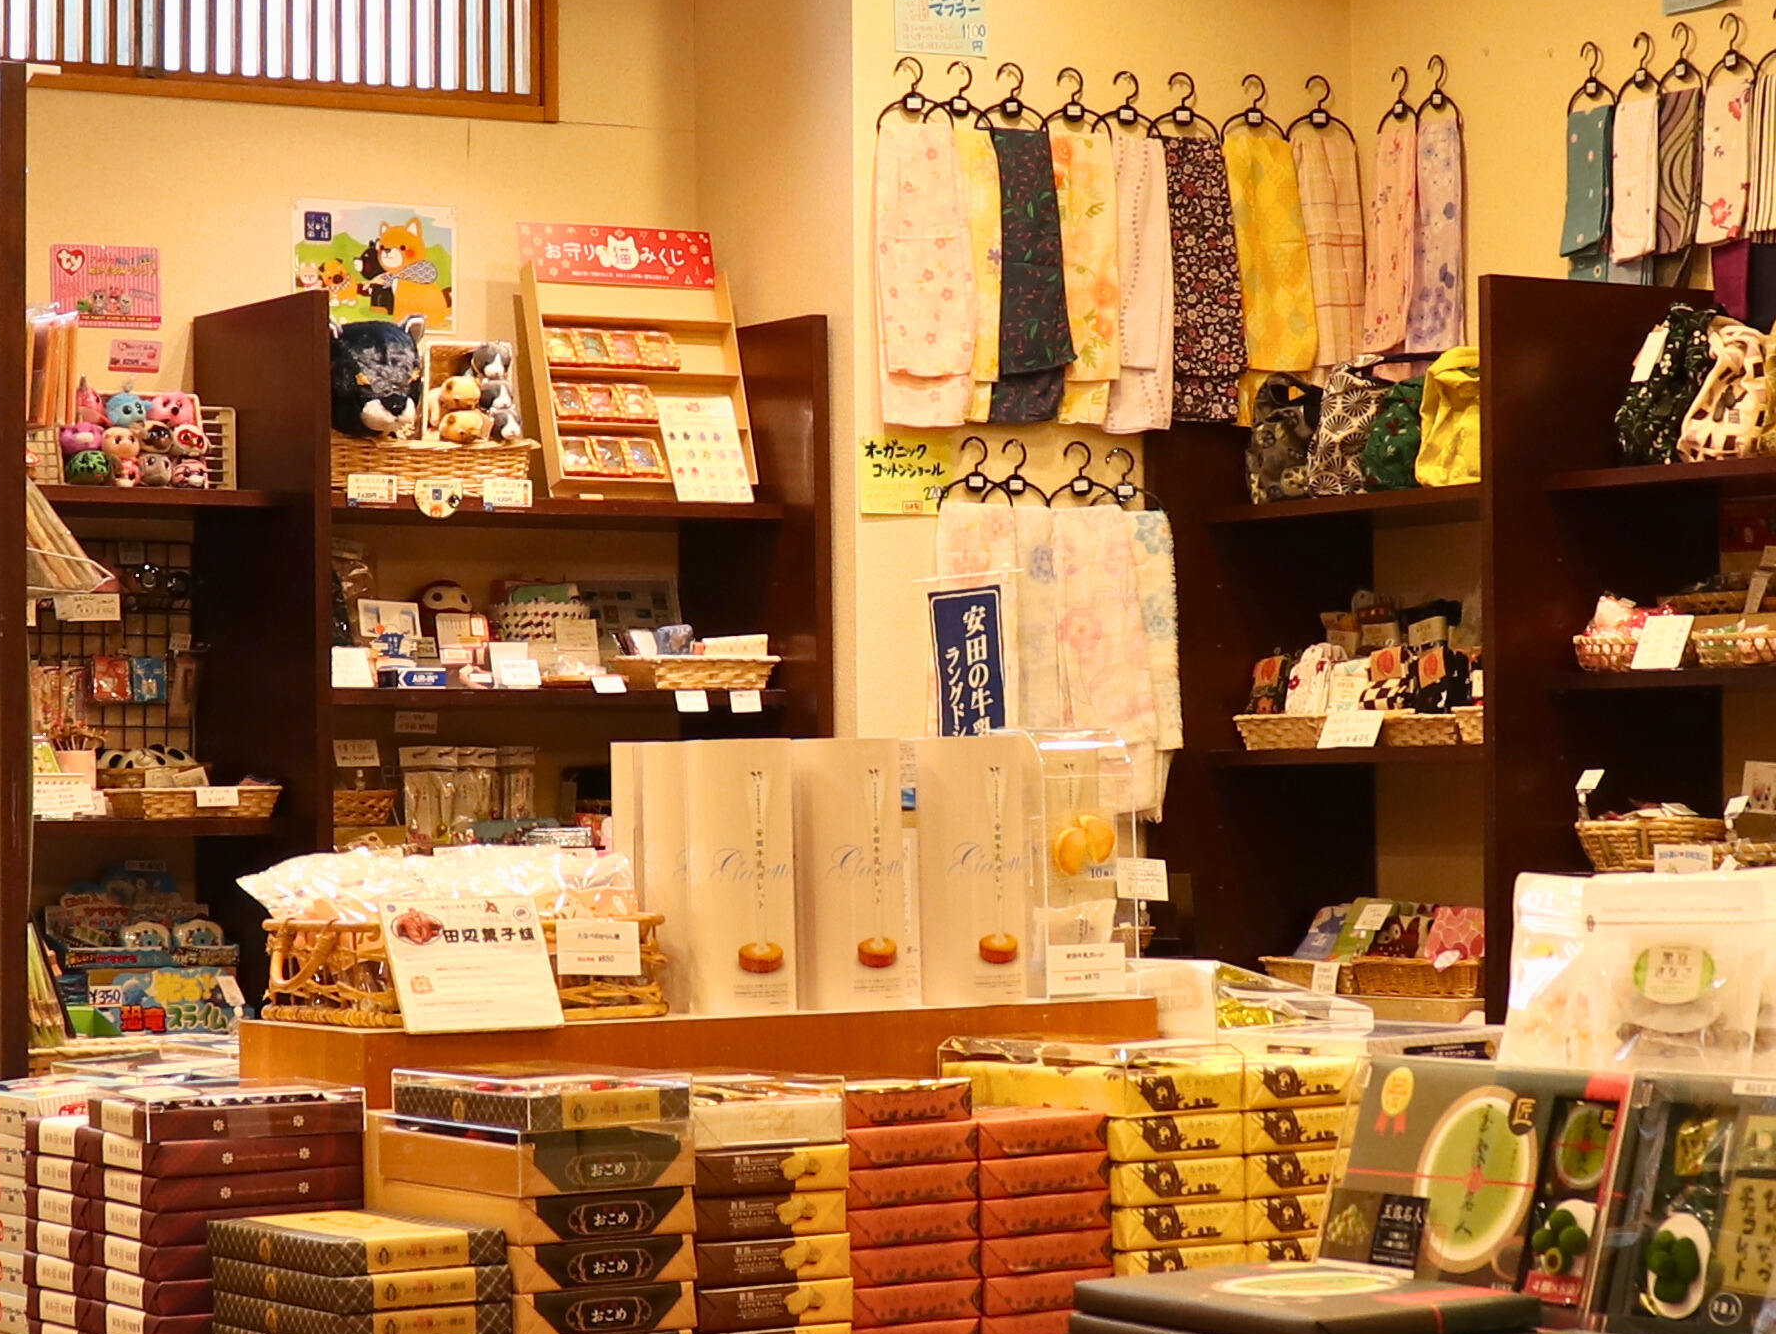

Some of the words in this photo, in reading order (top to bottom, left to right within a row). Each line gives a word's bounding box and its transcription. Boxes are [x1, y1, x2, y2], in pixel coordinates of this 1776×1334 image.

[928, 2, 980, 19] マフラー
[57, 249, 83, 272] ty
[544, 240, 686, 268] お守り猫みくじ
[864, 438, 927, 460] オーガニック
[872, 461, 946, 478] コットンショール
[962, 604, 995, 737] 安田の牛乳
[90, 989, 121, 1004] ¥350
[590, 1162, 626, 1179] おこめ
[593, 1211, 630, 1227] おこめ
[592, 1259, 629, 1275] おこめ
[590, 1308, 627, 1323] おこめ
